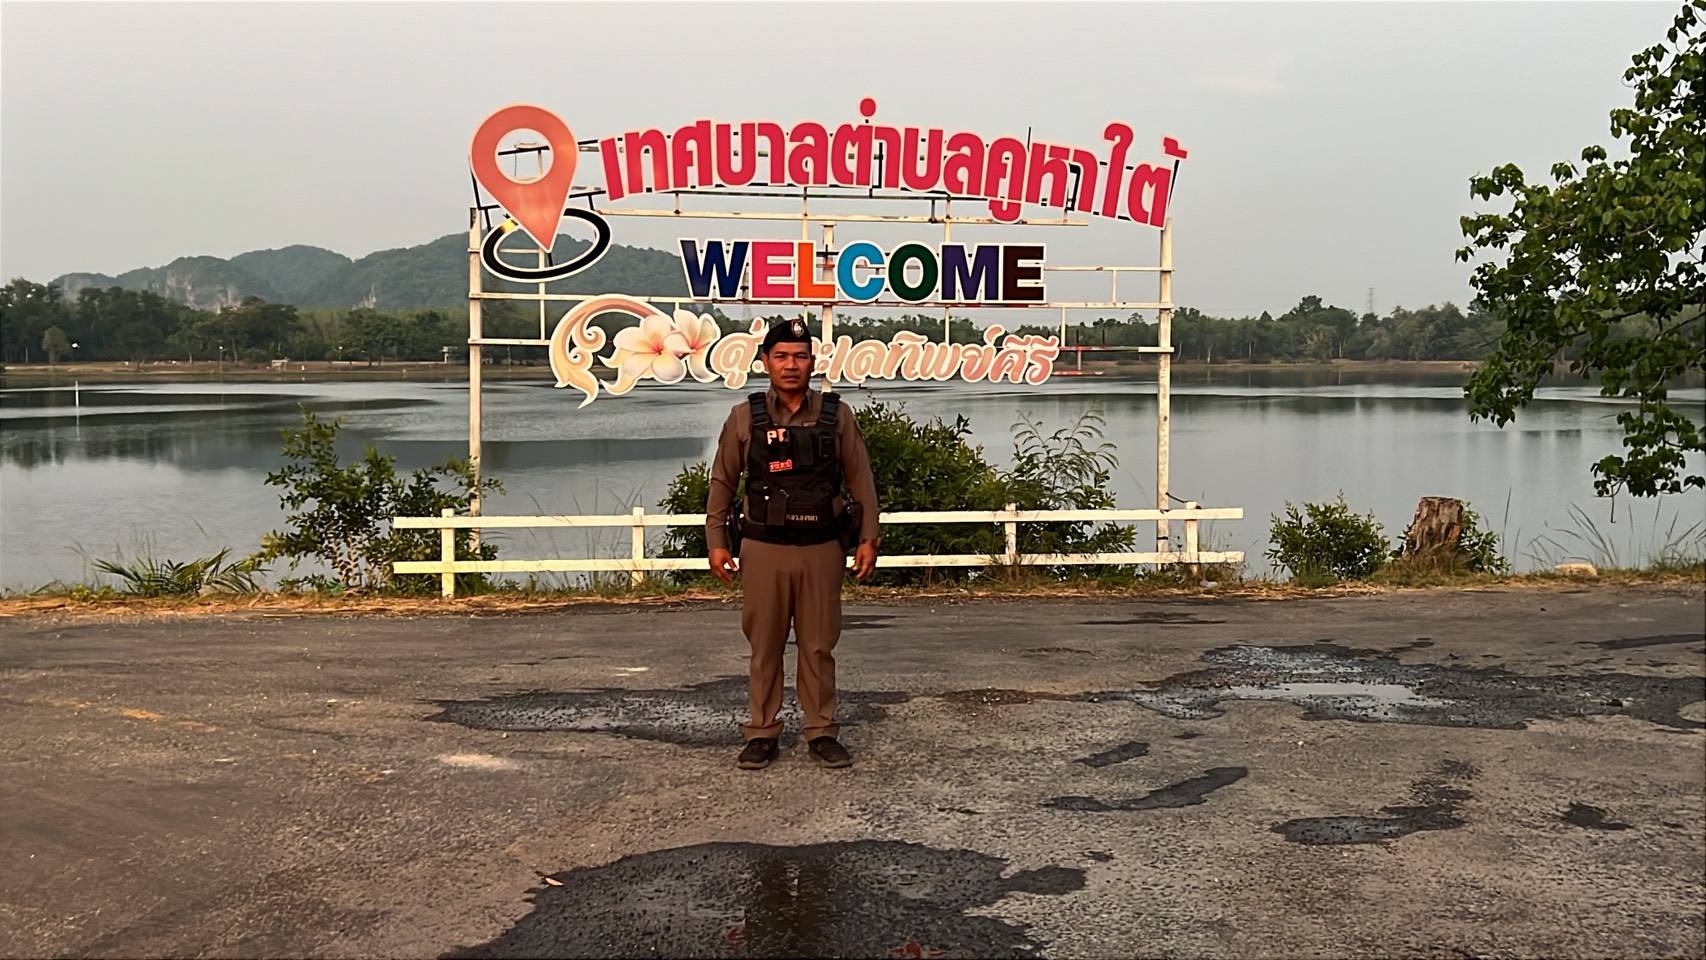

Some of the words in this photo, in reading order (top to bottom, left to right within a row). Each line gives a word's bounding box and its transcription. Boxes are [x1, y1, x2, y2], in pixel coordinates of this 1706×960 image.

[600, 97, 1187, 228] เทศบาลตำบลคูหาใต้
[680, 239, 1045, 303] WELCOME
[711, 316, 1059, 389] สู่ะเลทิพย์คีรี
